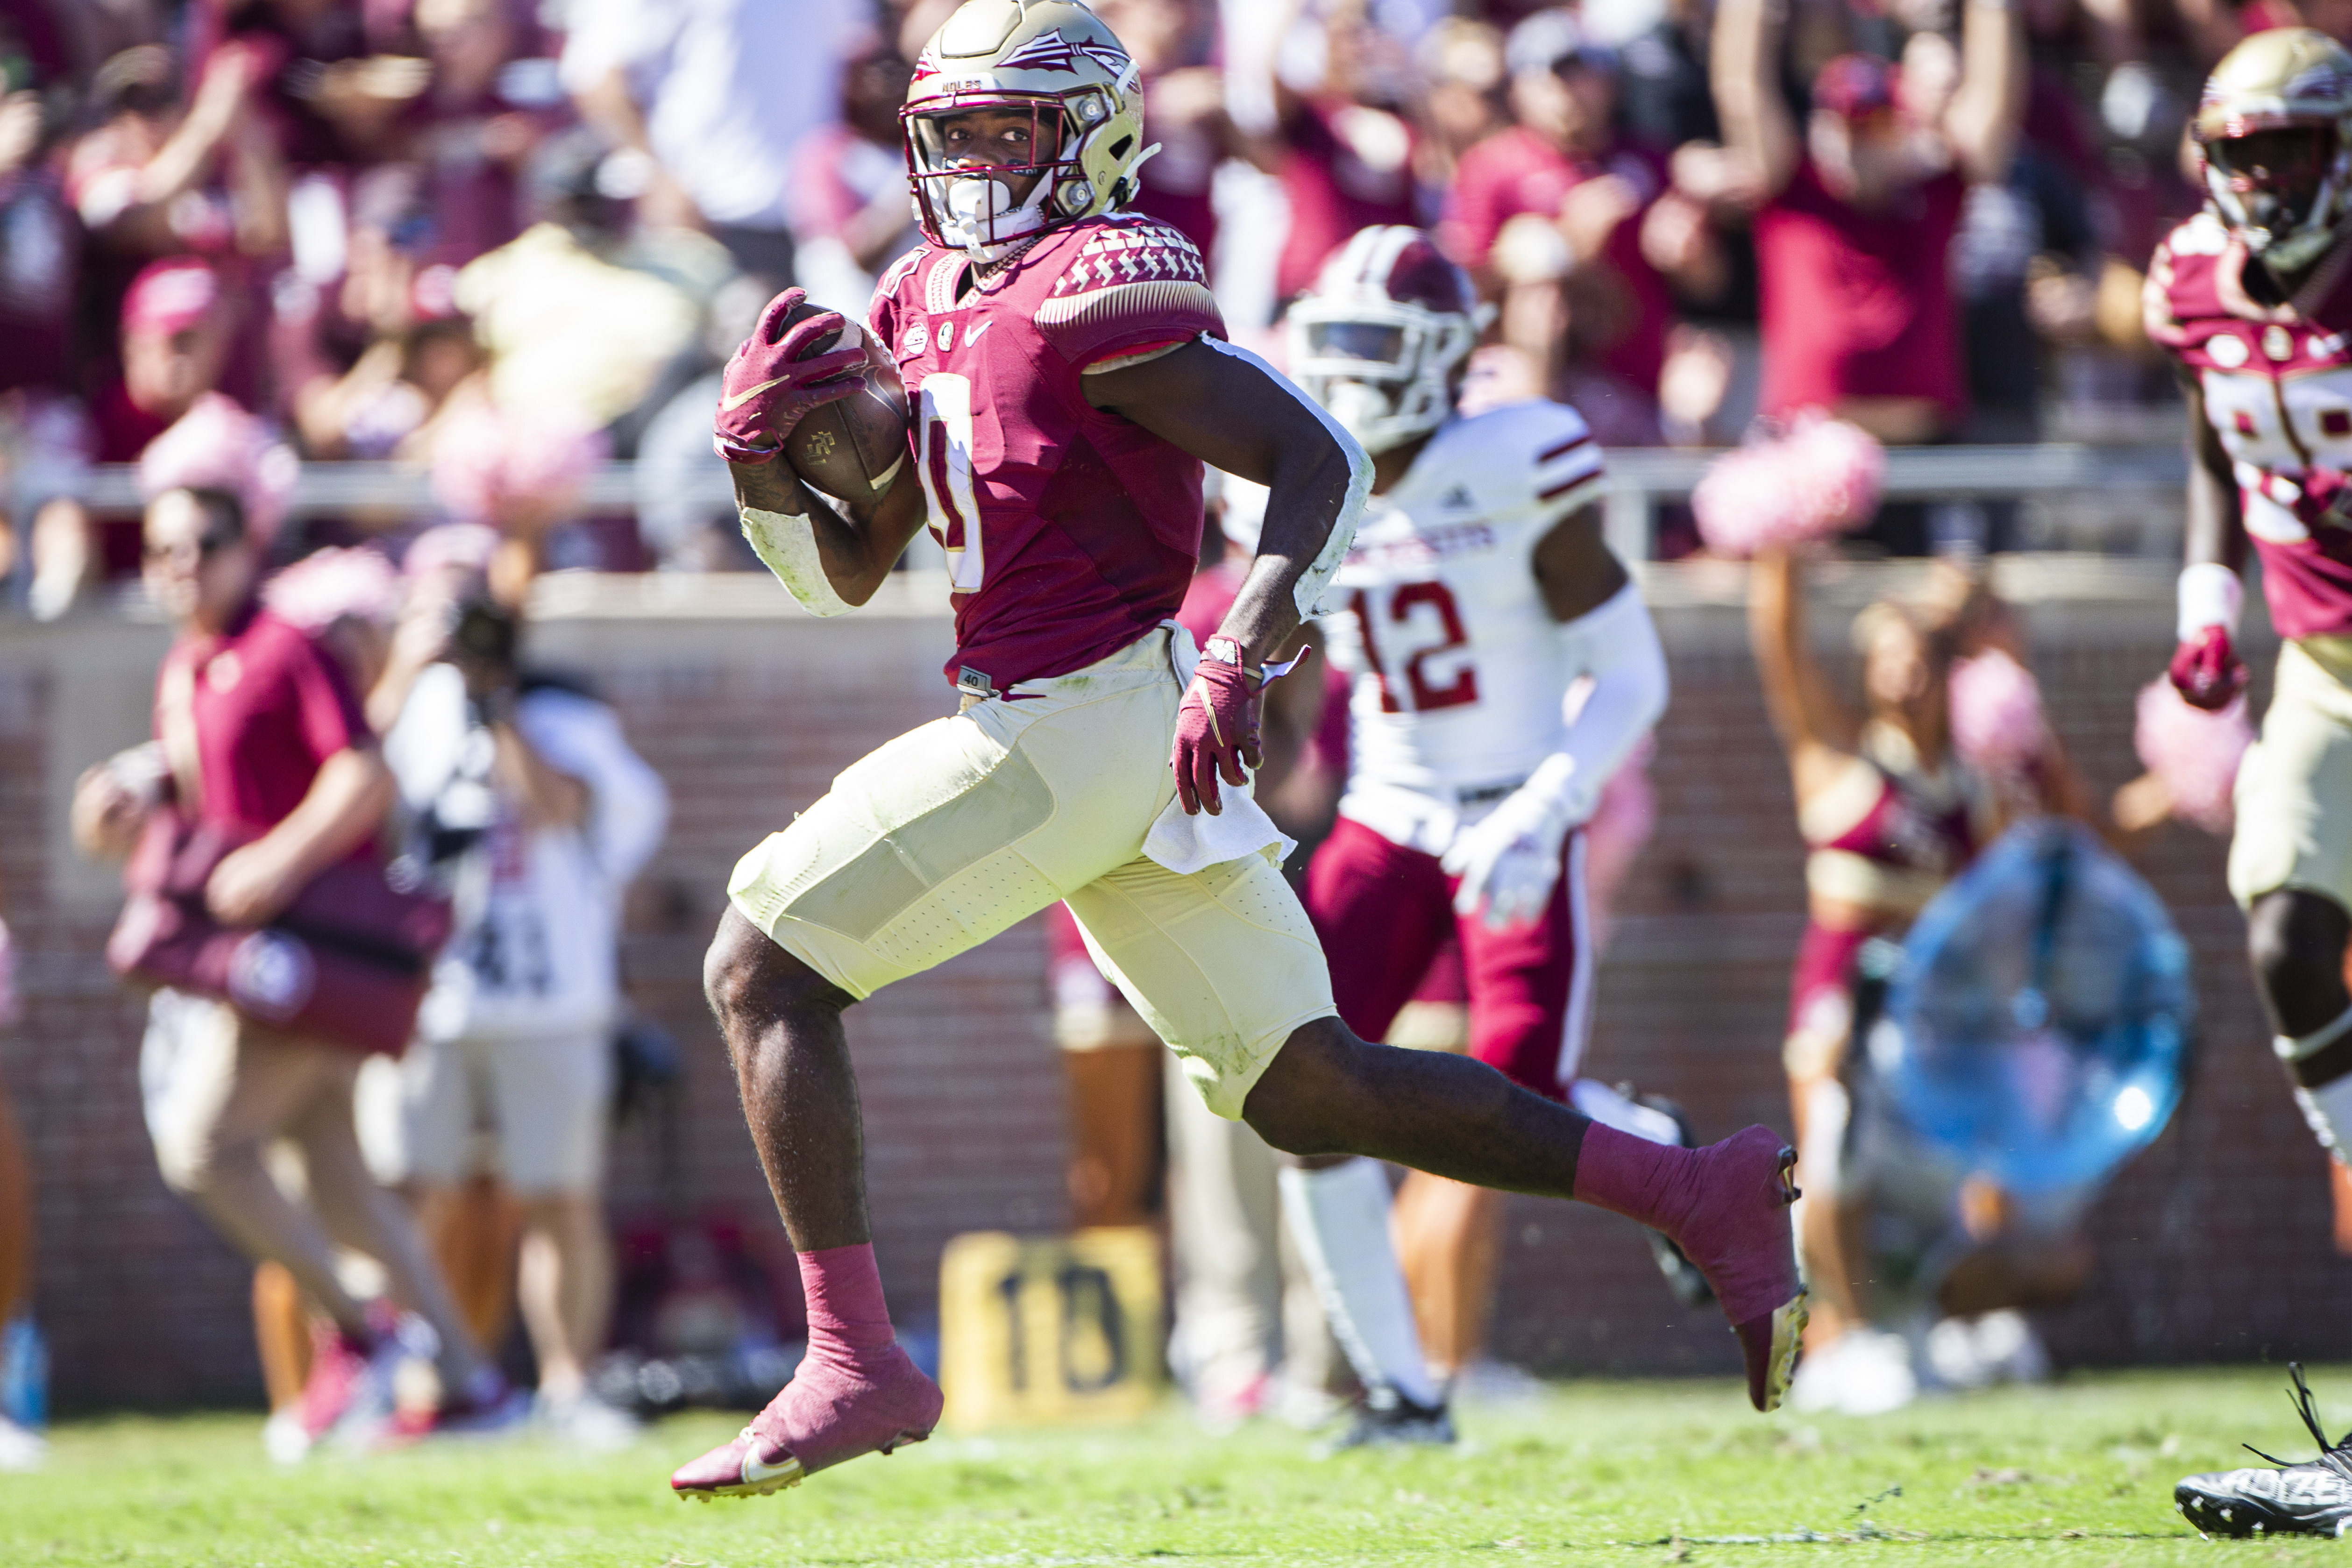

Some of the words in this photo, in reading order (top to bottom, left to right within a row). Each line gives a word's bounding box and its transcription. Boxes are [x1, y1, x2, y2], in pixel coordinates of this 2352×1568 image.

[942, 80, 981, 92] NOLES
[918, 372, 985, 594] 0
[964, 674, 978, 687] 40
[1347, 579, 1479, 715] 12
[999, 1263, 1129, 1396] 10
